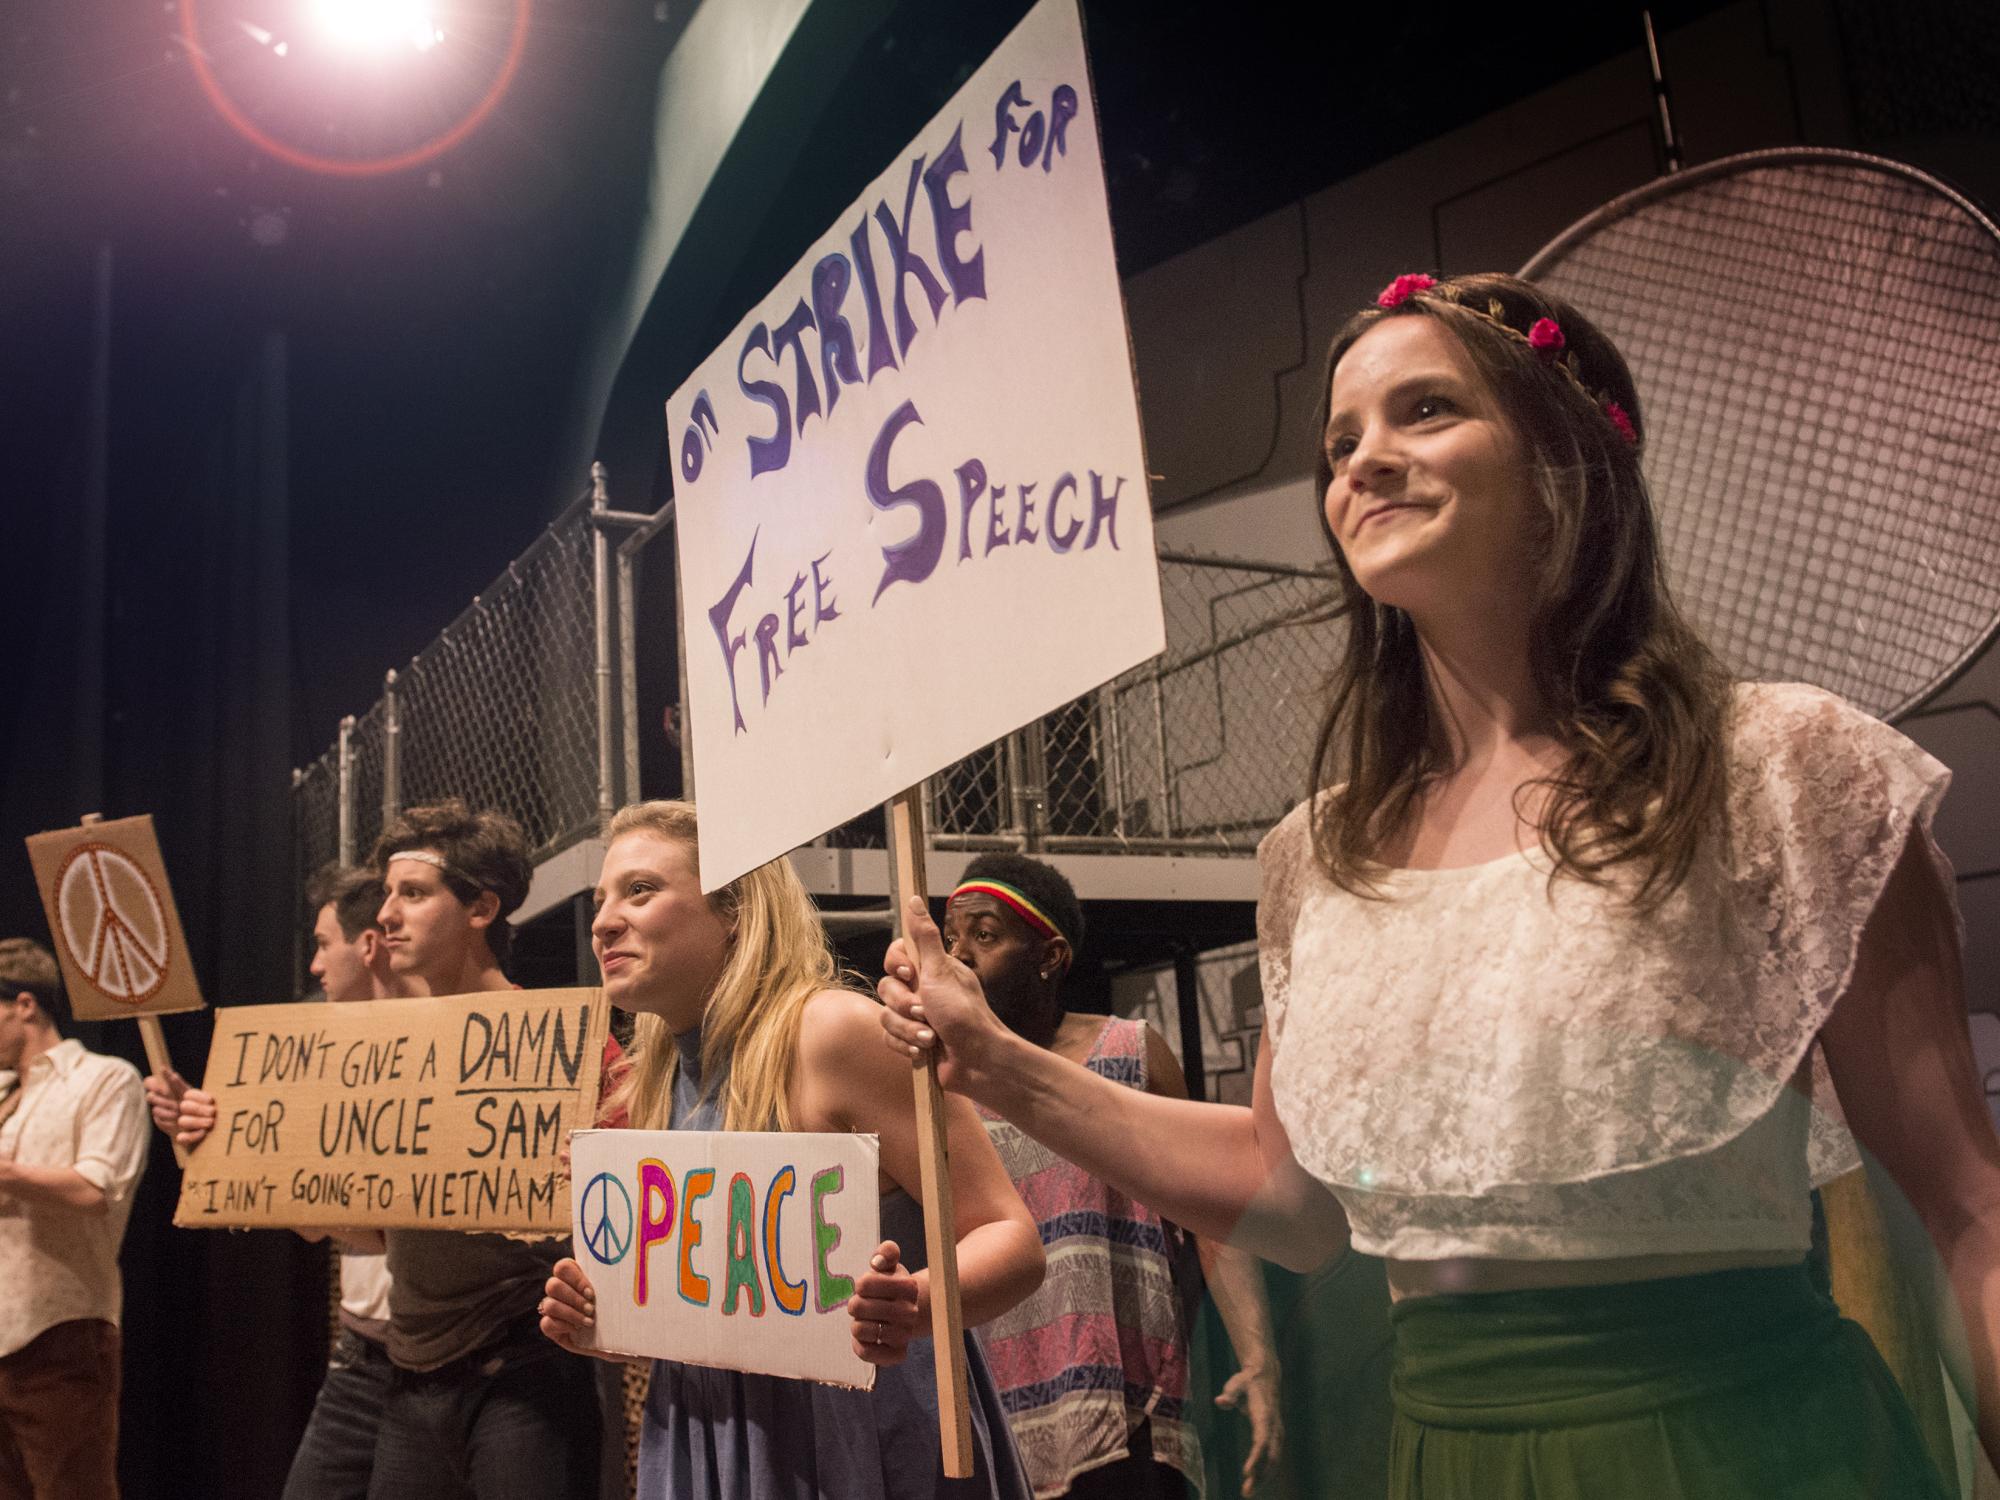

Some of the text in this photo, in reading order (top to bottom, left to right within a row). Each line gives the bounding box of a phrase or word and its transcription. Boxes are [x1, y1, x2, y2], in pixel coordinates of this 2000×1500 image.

[737, 119, 988, 480] STRIKE
[989, 80, 1079, 173] FOR
[708, 398, 1128, 737] FREE SPEECH
[226, 1005, 589, 1087] I DON'T GIVE A DAMN
[227, 1097, 561, 1159] FOR UNCLE SAM
[224, 1175, 277, 1214] AIN'T
[633, 1157, 855, 1317] PEACE
